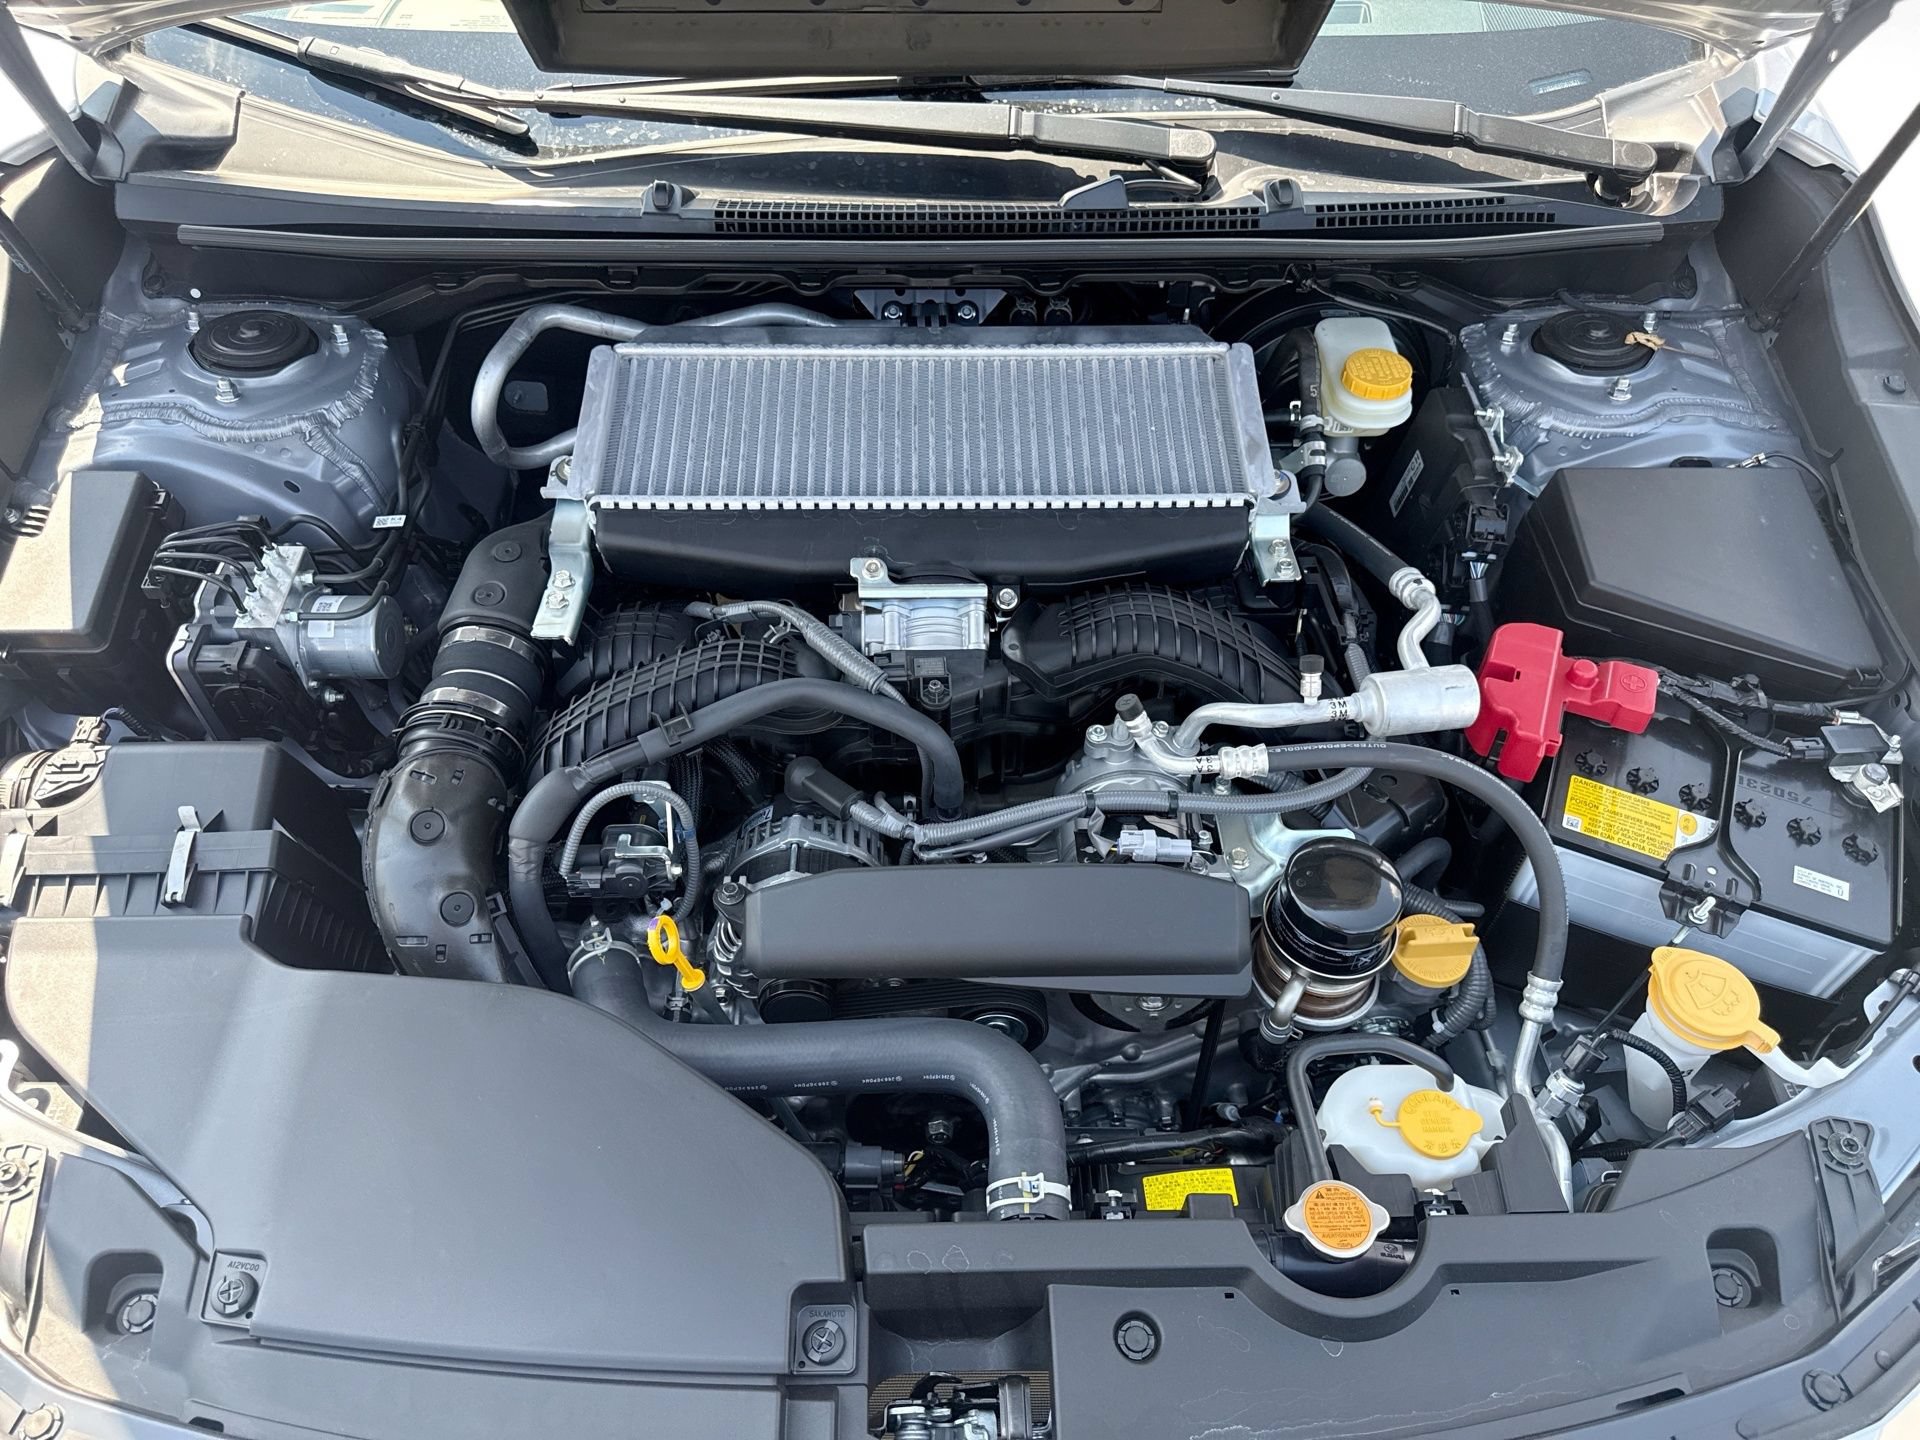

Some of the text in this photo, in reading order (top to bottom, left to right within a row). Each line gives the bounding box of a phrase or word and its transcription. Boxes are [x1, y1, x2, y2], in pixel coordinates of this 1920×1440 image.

[1330, 701, 1347, 709] 3M
[1330, 710, 1348, 719] 3M
[1573, 777, 1603, 791] DANGER
[1569, 796, 1599, 810] POISON
